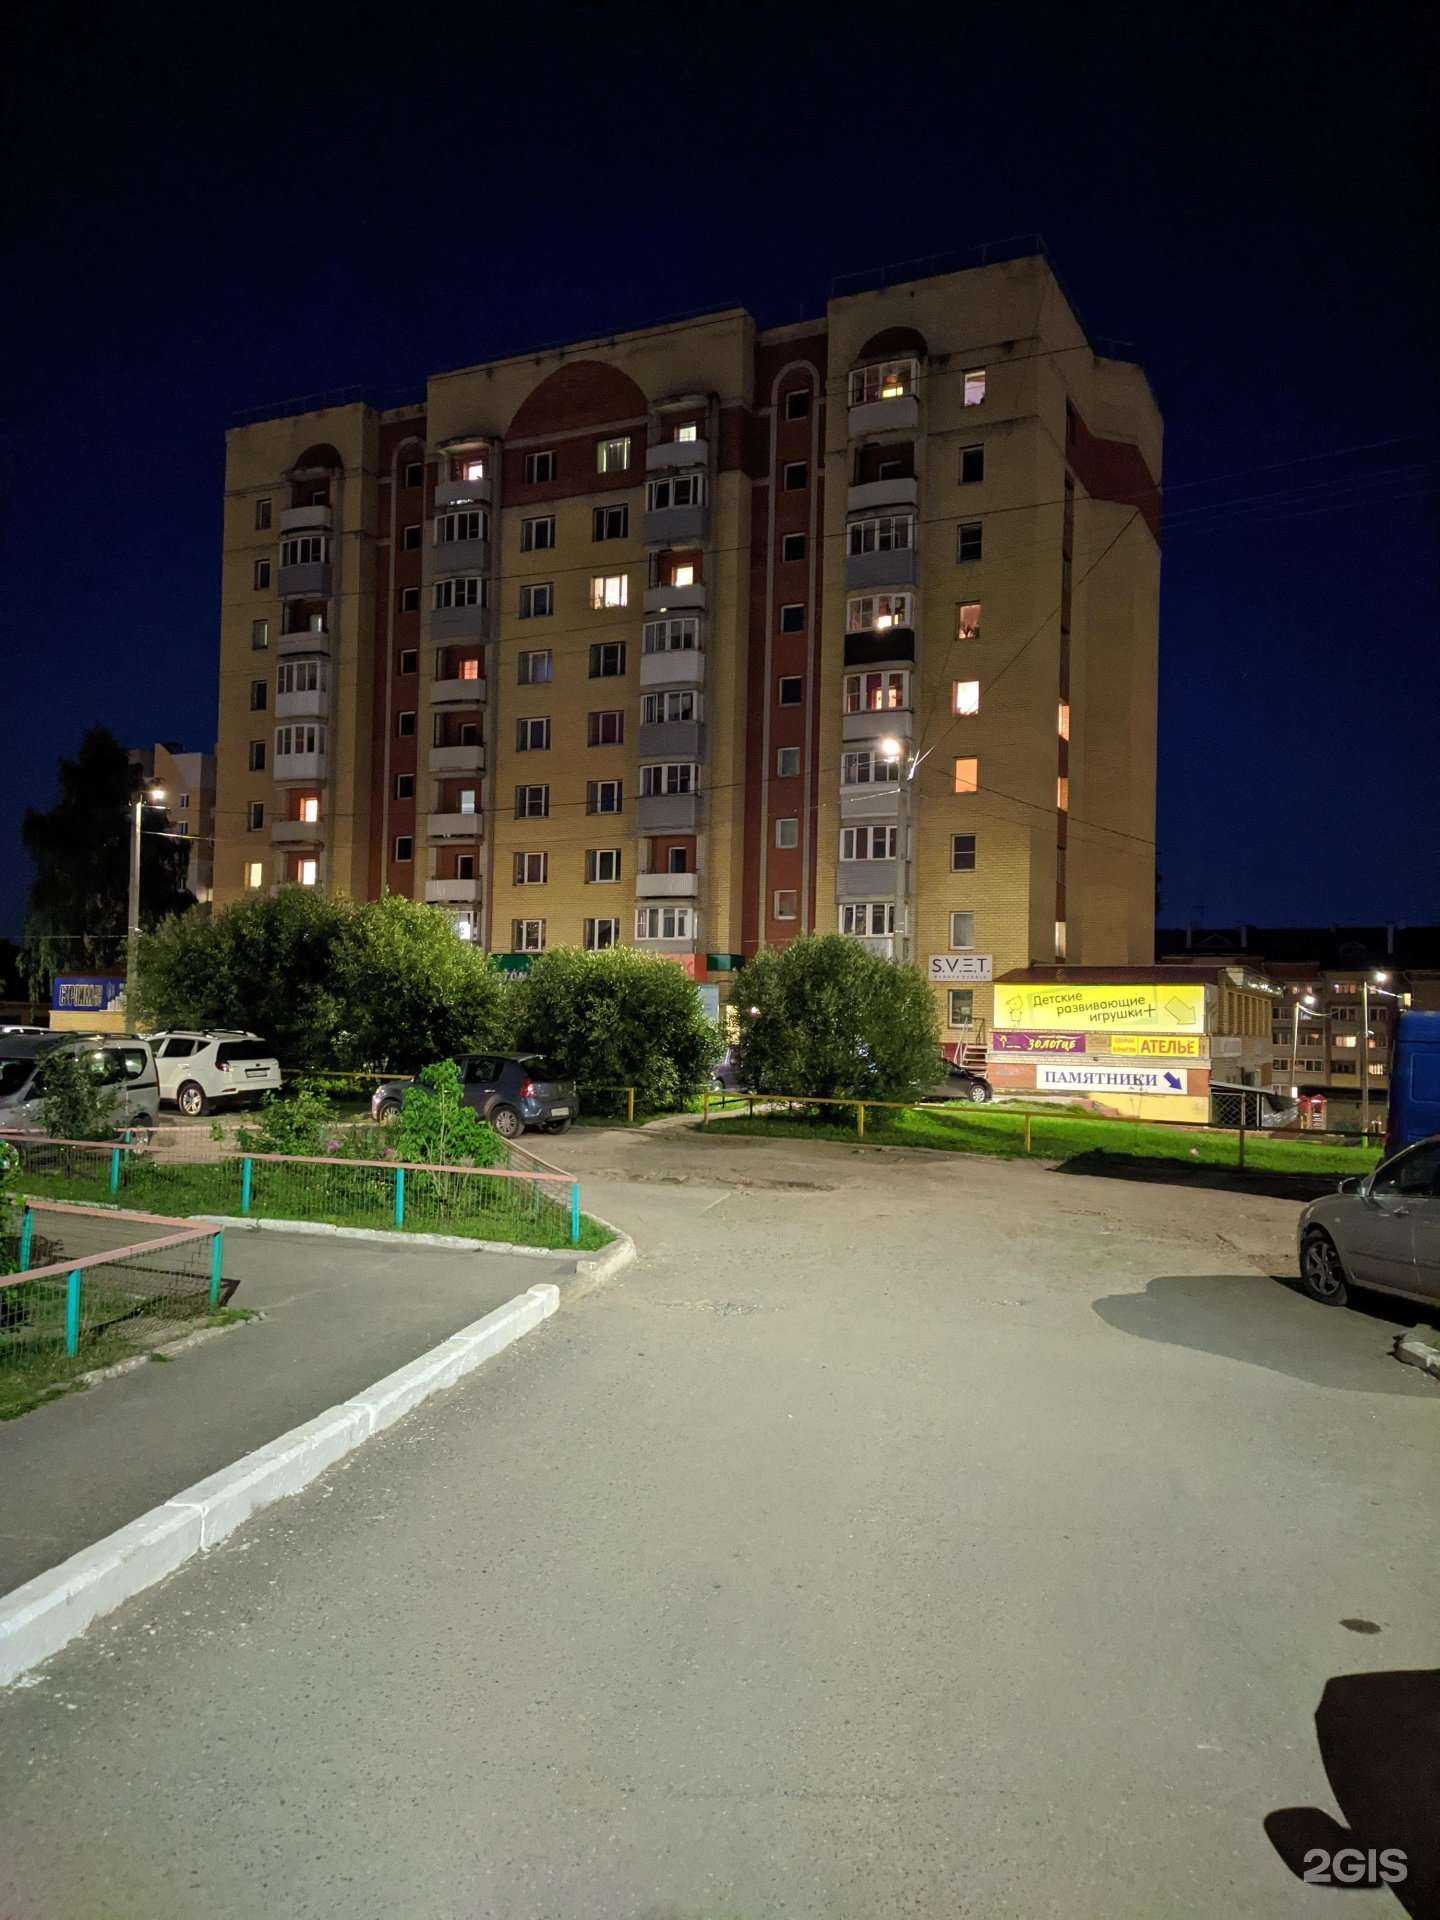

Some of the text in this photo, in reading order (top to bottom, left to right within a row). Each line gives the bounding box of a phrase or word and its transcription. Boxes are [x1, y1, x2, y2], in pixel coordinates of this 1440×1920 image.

[1033, 992, 1083, 1007] Детские
[1056, 996, 1146, 1016] развивающие
[1140, 1039, 1195, 1054] АТЕЛЬЕ
[1045, 1071, 1158, 1086] ПАМЯТНИКИ
